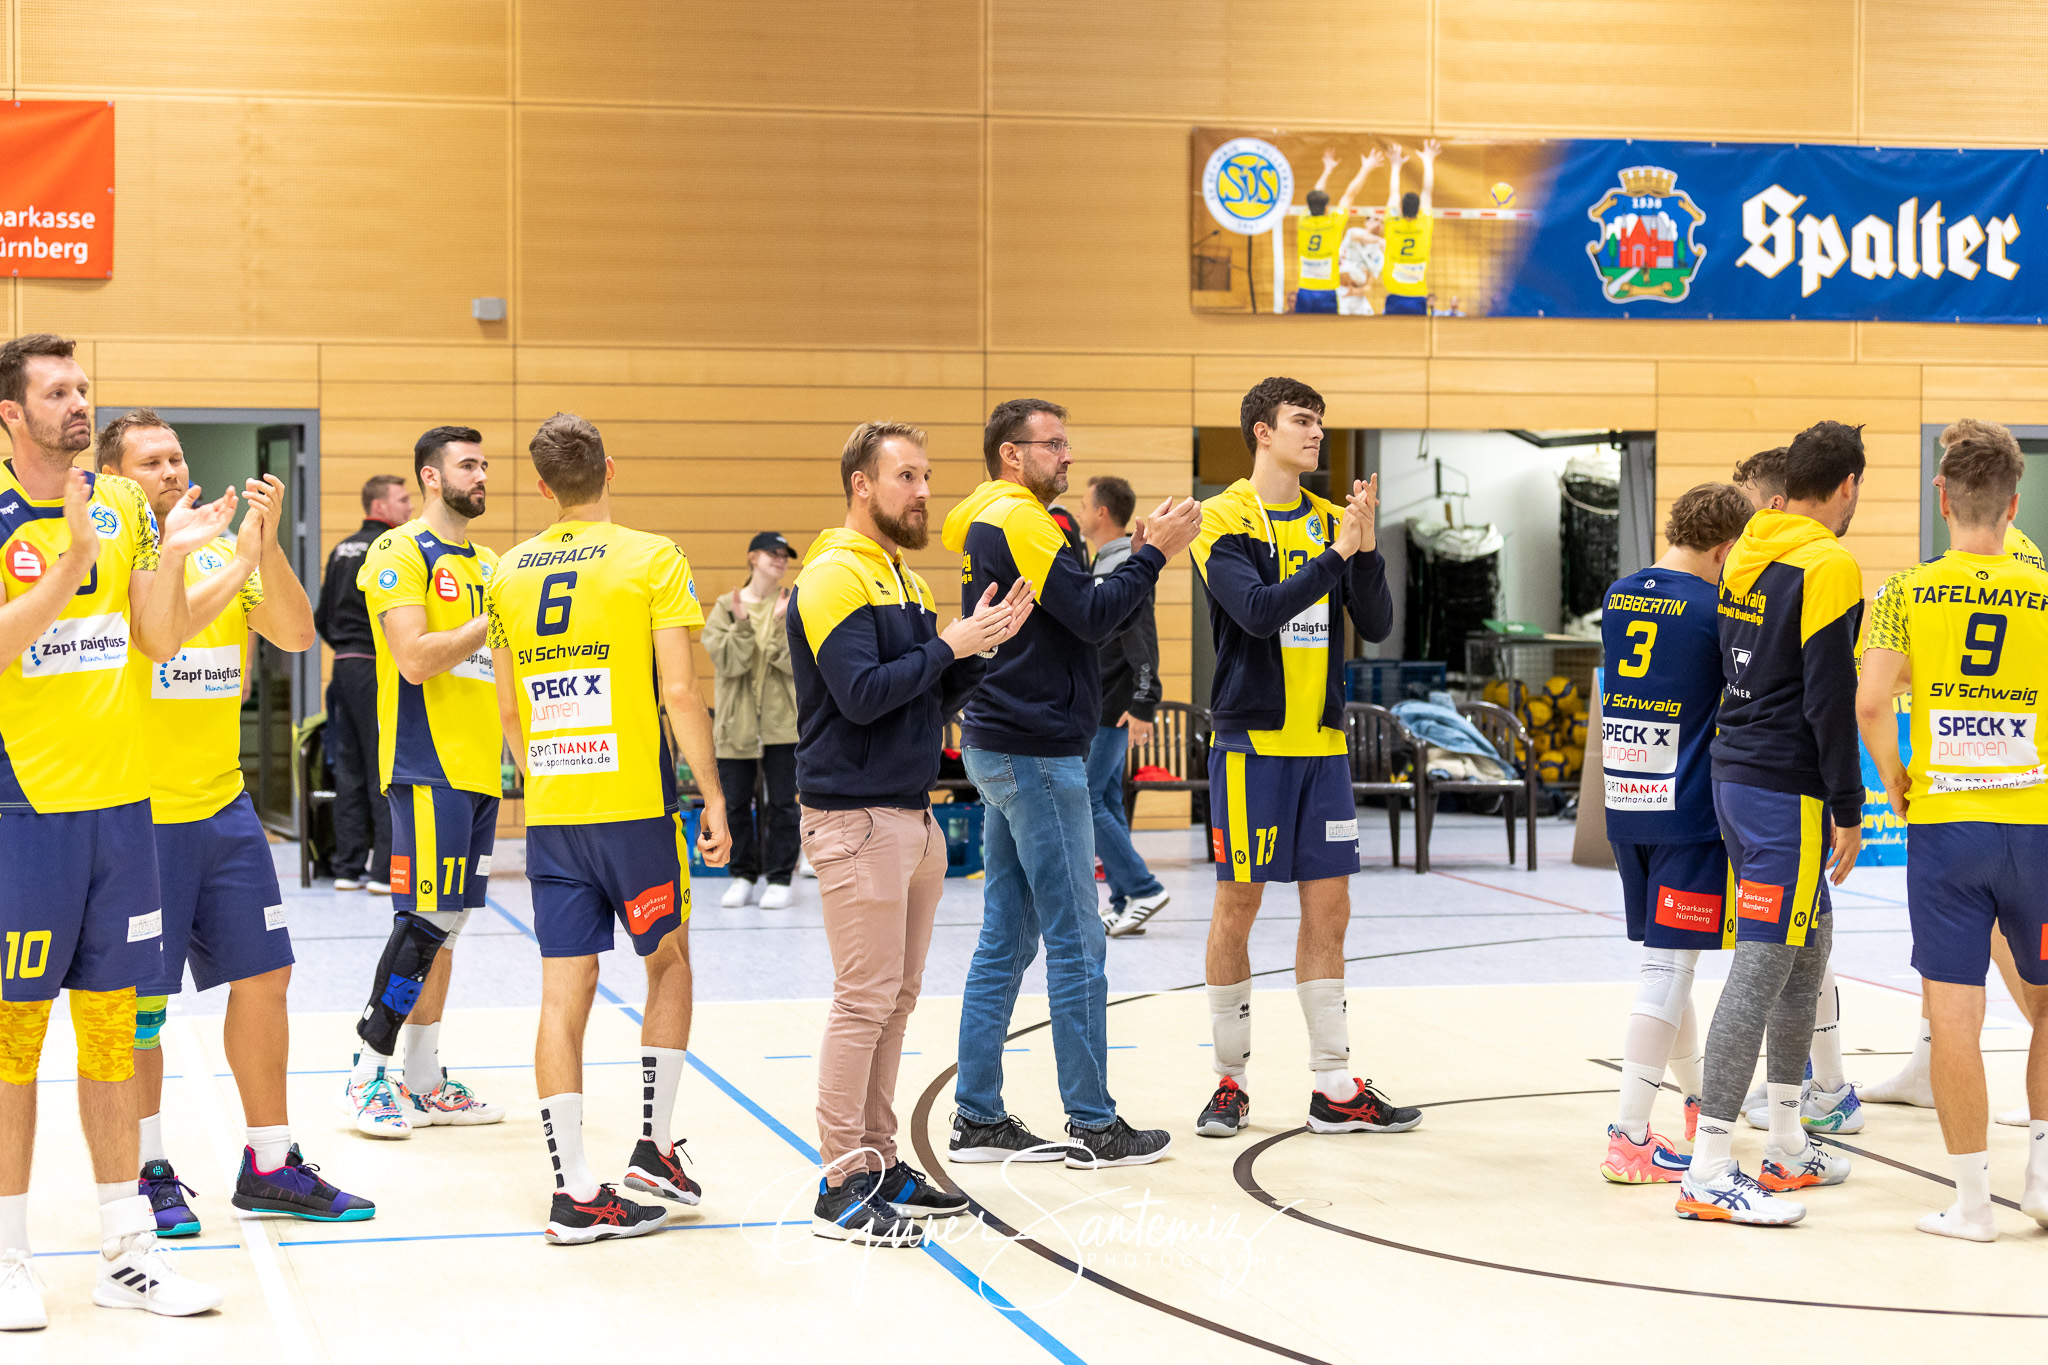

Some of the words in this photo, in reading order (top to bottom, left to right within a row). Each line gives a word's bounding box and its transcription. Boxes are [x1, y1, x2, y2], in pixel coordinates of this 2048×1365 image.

[1400, 239, 1415, 256] 2
[1735, 184, 2021, 298] Spalter
[517, 544, 608, 569] BIBRACK
[536, 571, 577, 636] 6
[1608, 594, 1687, 615] DOBBERTIN
[42, 640, 77, 656] Zapf
[80, 636, 126, 652] Daigfuss
[518, 649, 532, 665] SV
[535, 641, 610, 661] Schwaig
[1618, 620, 1658, 678] 3
[1960, 612, 2007, 676] 9
[173, 668, 202, 683] Zapf
[531, 676, 578, 701] PECK
[1930, 683, 1955, 697] SV
[1959, 684, 2038, 706] Schwaig
[1612, 695, 1682, 717] Schwaig
[1938, 716, 2005, 736] SPECK
[1938, 741, 2008, 760] pumpen
[1256, 826, 1278, 866] 13
[443, 857, 466, 895] 11
[1677, 902, 1713, 914] Sparkasse
[1742, 901, 1769, 913] Nürnberg
[1744, 892, 1773, 903] Sparkasse
[1676, 912, 1710, 923] Nürnberg
[5, 930, 52, 980] 10
